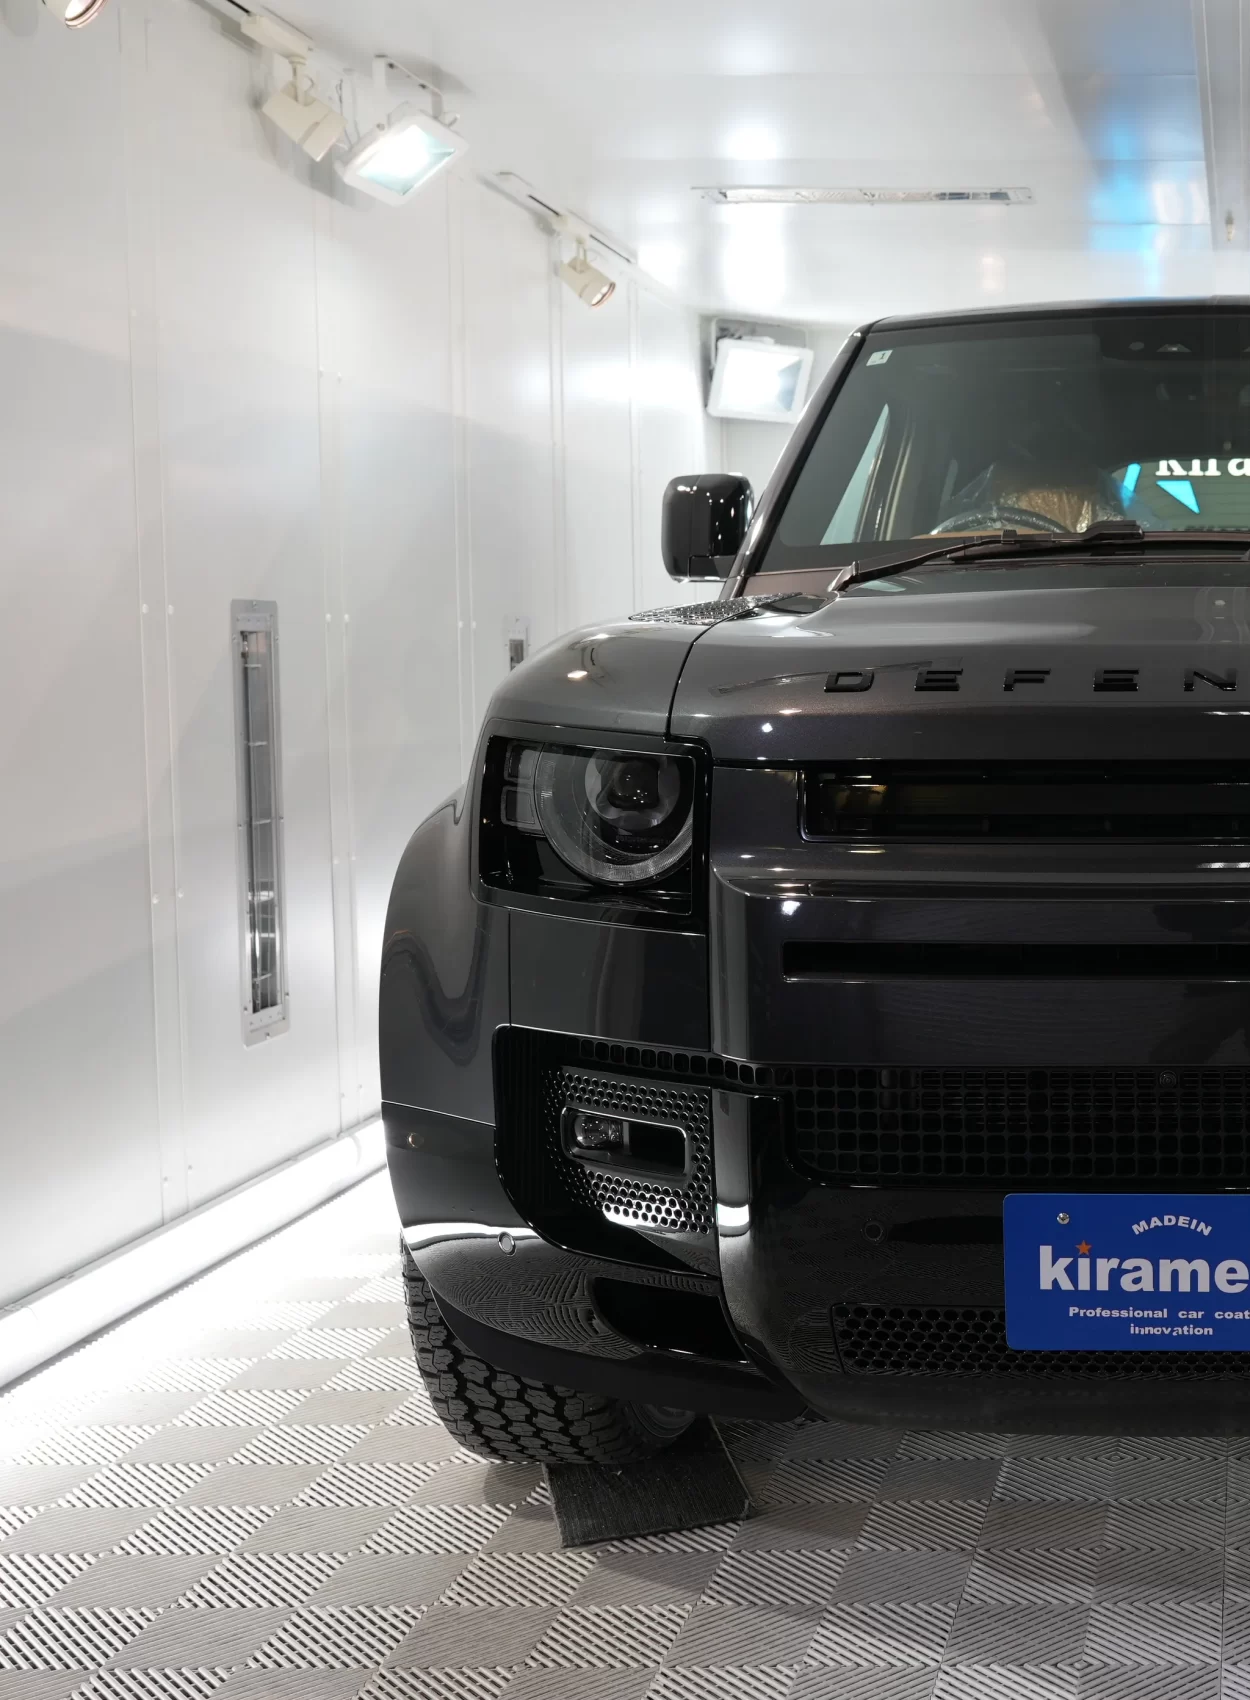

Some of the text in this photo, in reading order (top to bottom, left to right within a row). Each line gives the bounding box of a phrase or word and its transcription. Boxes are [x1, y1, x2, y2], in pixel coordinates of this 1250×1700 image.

[1131, 1215, 1213, 1236] MADEIN
[1068, 1306, 1168, 1319] Professional
[1177, 1309, 1205, 1320] car
[1130, 1323, 1213, 1336] innovation
